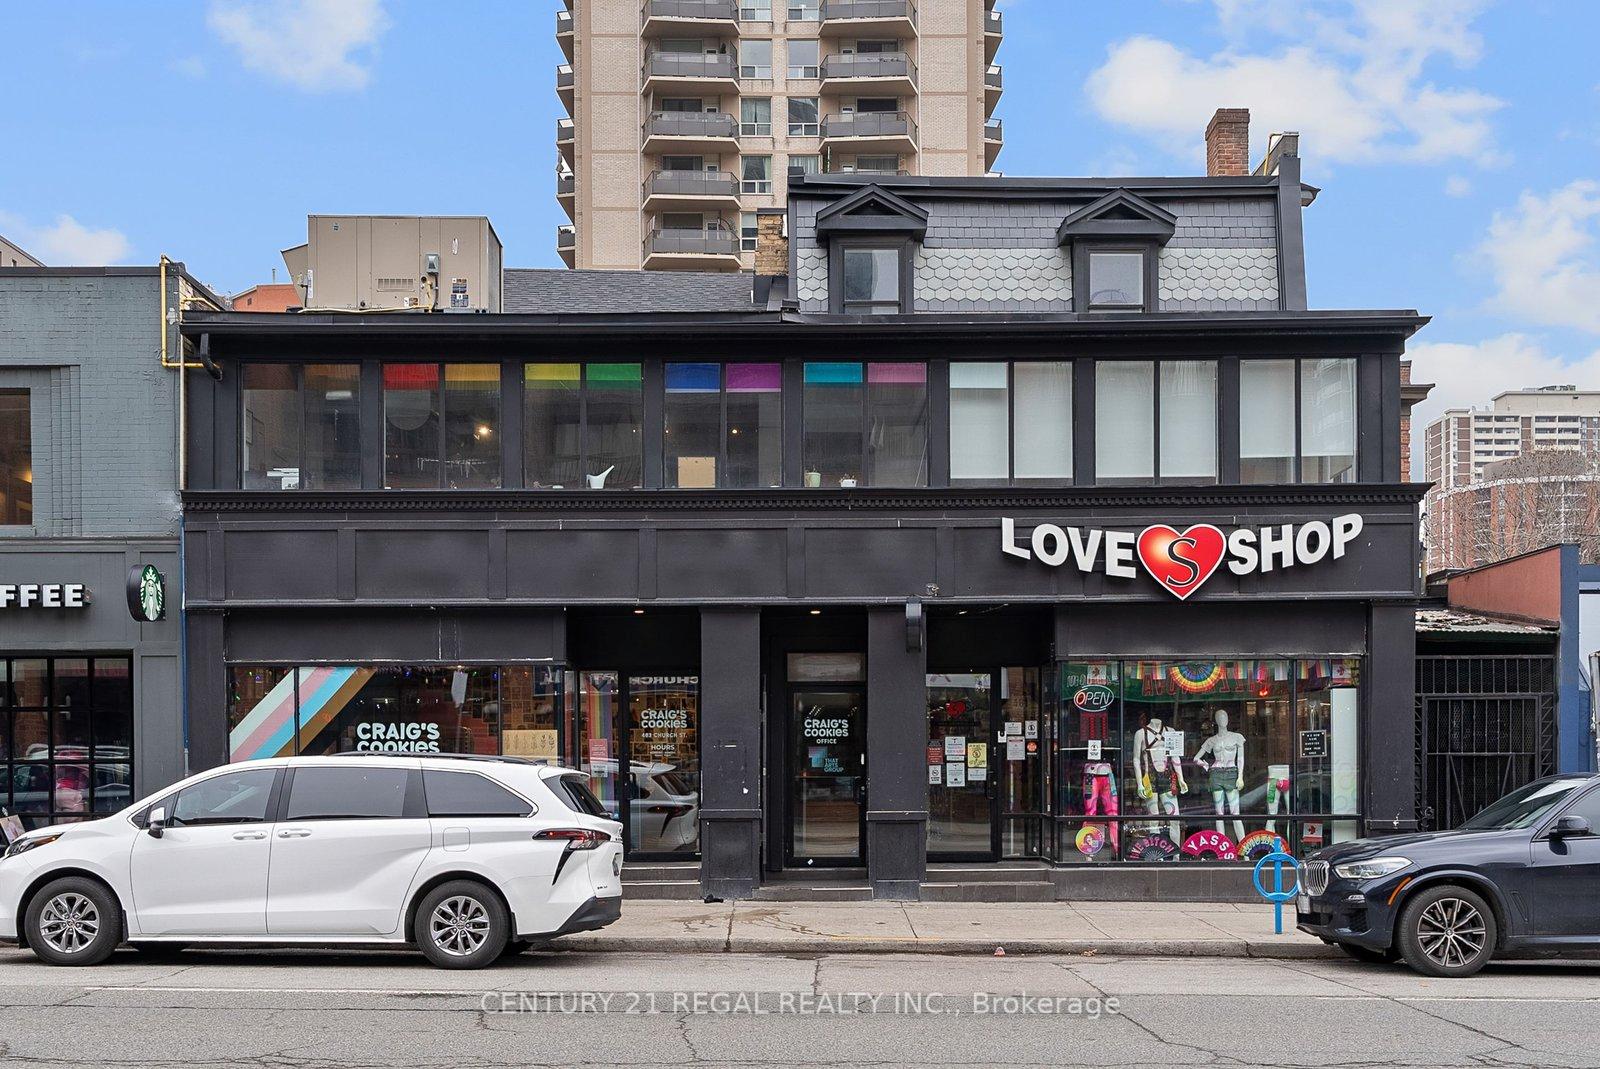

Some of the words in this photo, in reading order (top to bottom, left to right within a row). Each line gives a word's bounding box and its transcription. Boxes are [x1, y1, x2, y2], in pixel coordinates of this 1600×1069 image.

[1001, 517, 1137, 580] LOVE
[1165, 536, 1198, 588] S
[1227, 513, 1364, 576] SHOP
[0, 584, 83, 608] FFEE
[1075, 691, 1110, 706] OPEN
[641, 709, 688, 720] CRAIG'S
[356, 722, 441, 741] CRAIG'S
[804, 718, 849, 729] CRAIG'S
